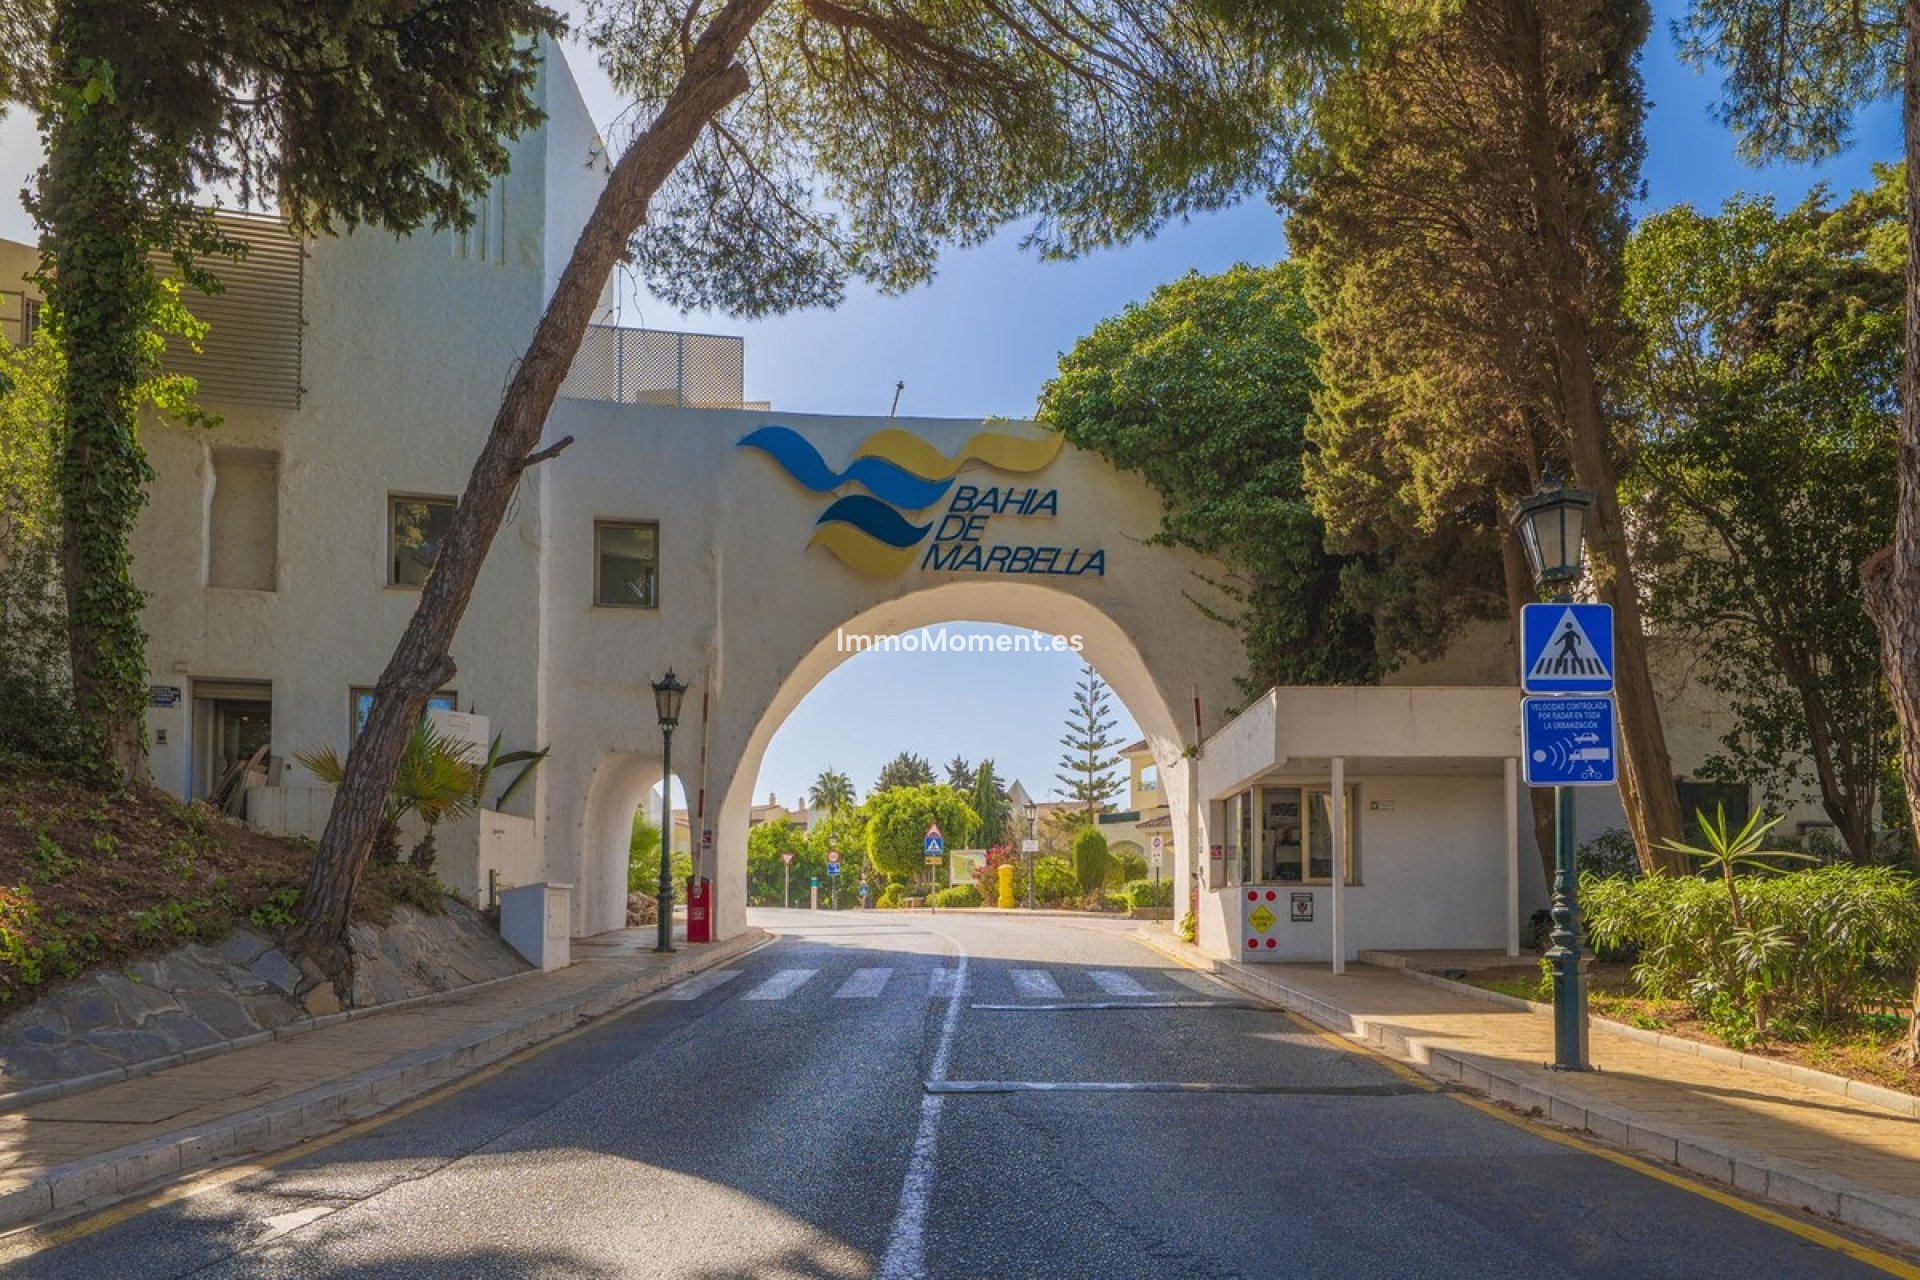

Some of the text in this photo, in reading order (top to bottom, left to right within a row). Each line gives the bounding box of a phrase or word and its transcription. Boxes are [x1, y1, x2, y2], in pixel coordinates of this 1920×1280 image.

[948, 485, 1058, 517] BAHIA
[935, 514, 990, 542] DE
[921, 543, 1105, 577] MARBELLA
[1531, 701, 1608, 711] VELOCIDAD CONTROLADA
[1538, 711, 1601, 720] POR RADAR EN TODA
[1543, 721, 1553, 730] LA
